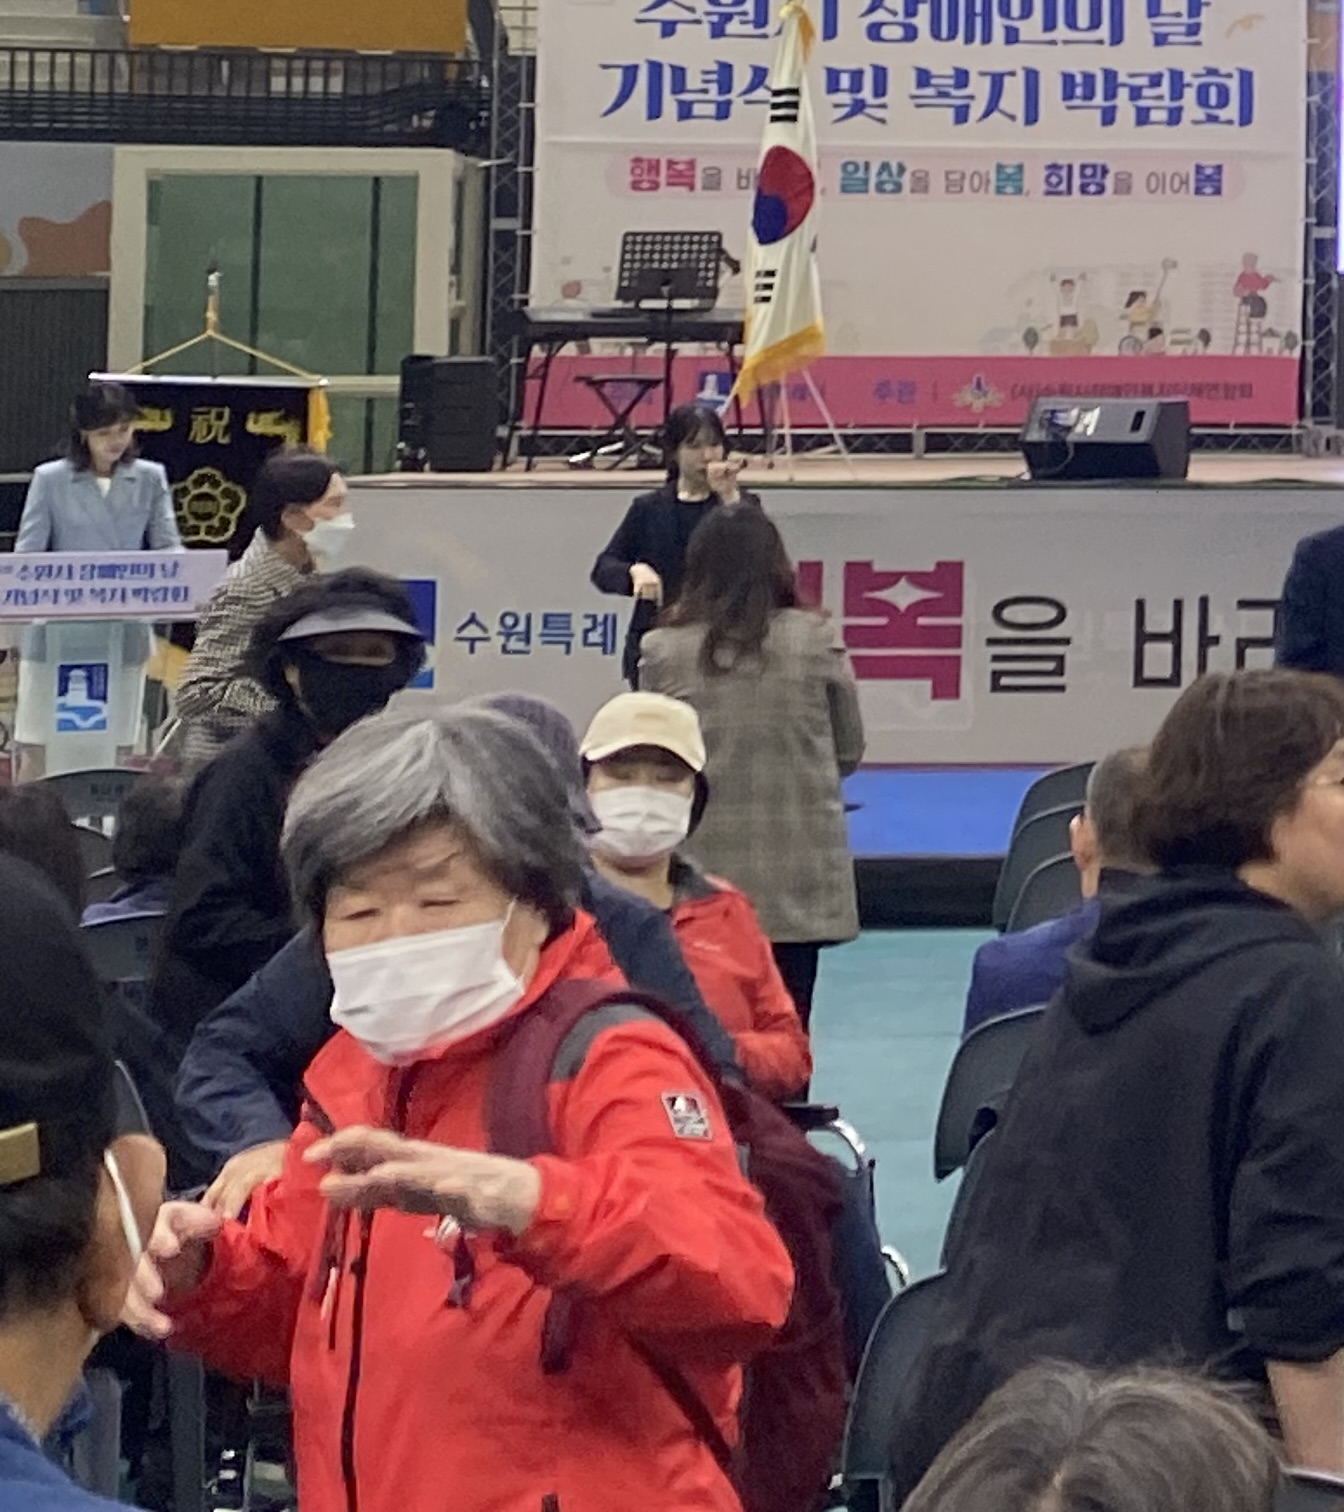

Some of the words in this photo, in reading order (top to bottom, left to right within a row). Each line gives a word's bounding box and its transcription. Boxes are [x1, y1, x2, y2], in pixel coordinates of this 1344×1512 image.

[823, 63, 888, 125] 및
[909, 65, 1040, 127] 복지
[1060, 65, 1254, 128] 박람회
[629, 156, 721, 193] 행복을
[839, 160, 930, 195] 일상을
[1043, 162, 1133, 196] 희망을
[1145, 163, 1223, 196] 이어봄
[188, 405, 231, 444] 祝
[453, 611, 618, 656] 수원특례
